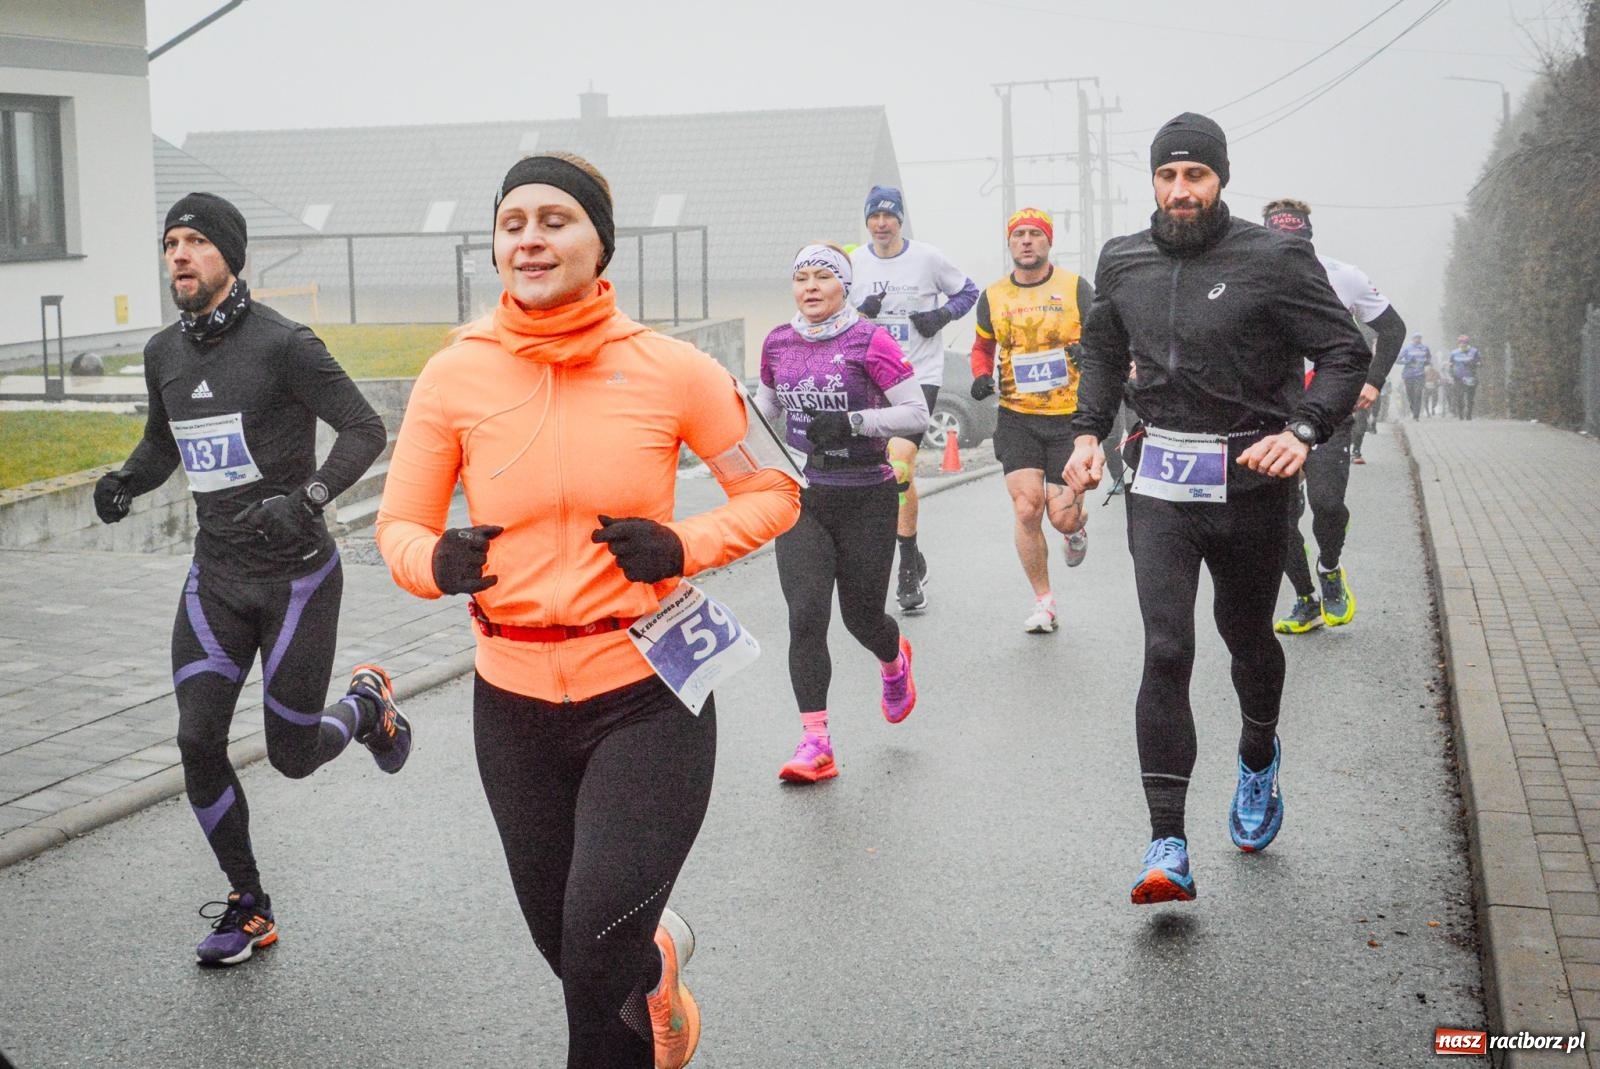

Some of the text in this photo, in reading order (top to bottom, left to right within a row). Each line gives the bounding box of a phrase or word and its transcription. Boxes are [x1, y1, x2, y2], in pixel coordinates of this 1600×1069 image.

[1027, 363, 1053, 381] 44
[187, 436, 229, 470] 137
[1160, 451, 1198, 483] 57
[656, 603, 675, 620] Cross
[675, 597, 684, 607] po
[680, 600, 737, 661] 59
